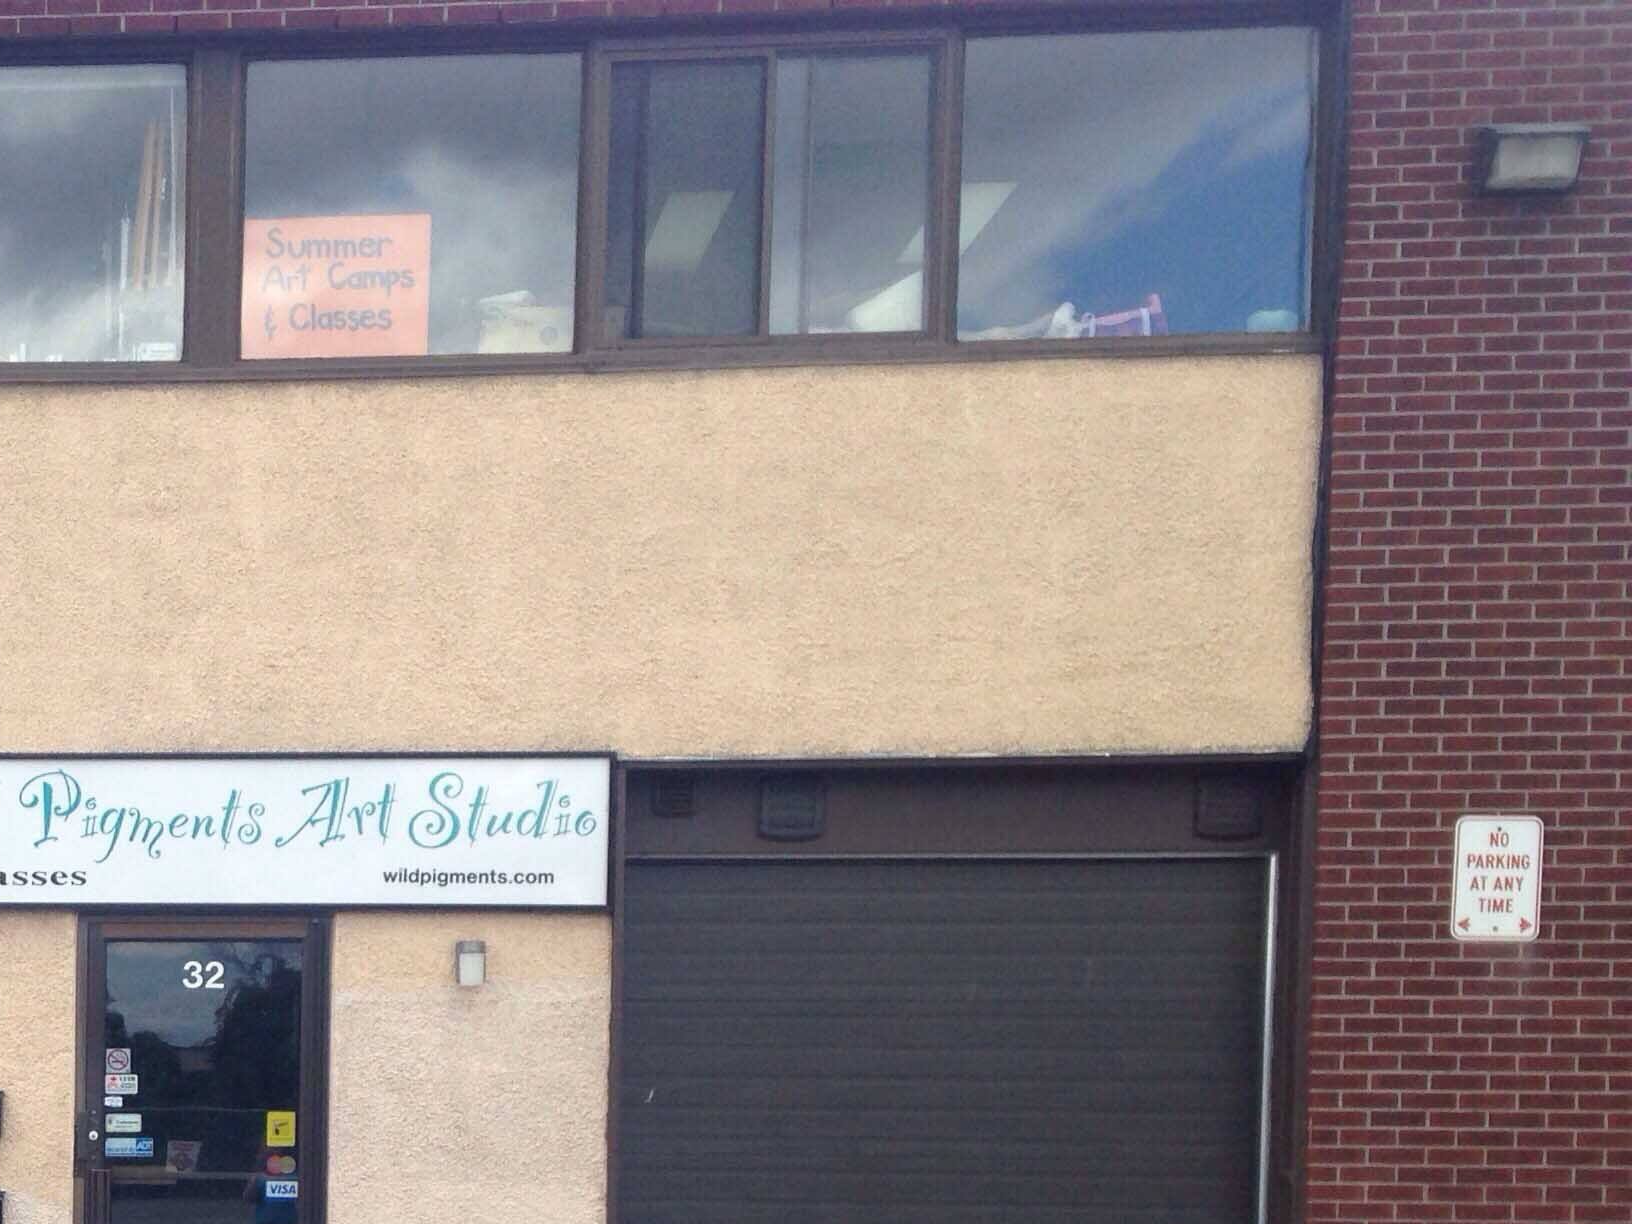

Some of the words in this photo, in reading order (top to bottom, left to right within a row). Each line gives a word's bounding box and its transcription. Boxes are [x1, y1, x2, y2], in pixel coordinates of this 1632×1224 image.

[266, 226, 393, 260] Summer
[262, 263, 311, 292] Art
[327, 261, 416, 298] Camps
[288, 302, 393, 331] Classes
[18, 769, 266, 863] Pigments
[274, 776, 398, 848] Art
[408, 772, 598, 849] Studio
[1489, 831, 1510, 847] NO
[1467, 853, 1531, 870] PARKING
[382, 867, 555, 887] wildpigments.com
[1469, 875, 1487, 891] AT
[1493, 875, 1524, 892] ANY
[1479, 897, 1514, 913] TIME
[181, 960, 225, 989] 32
[270, 1184, 297, 1194] VISA
